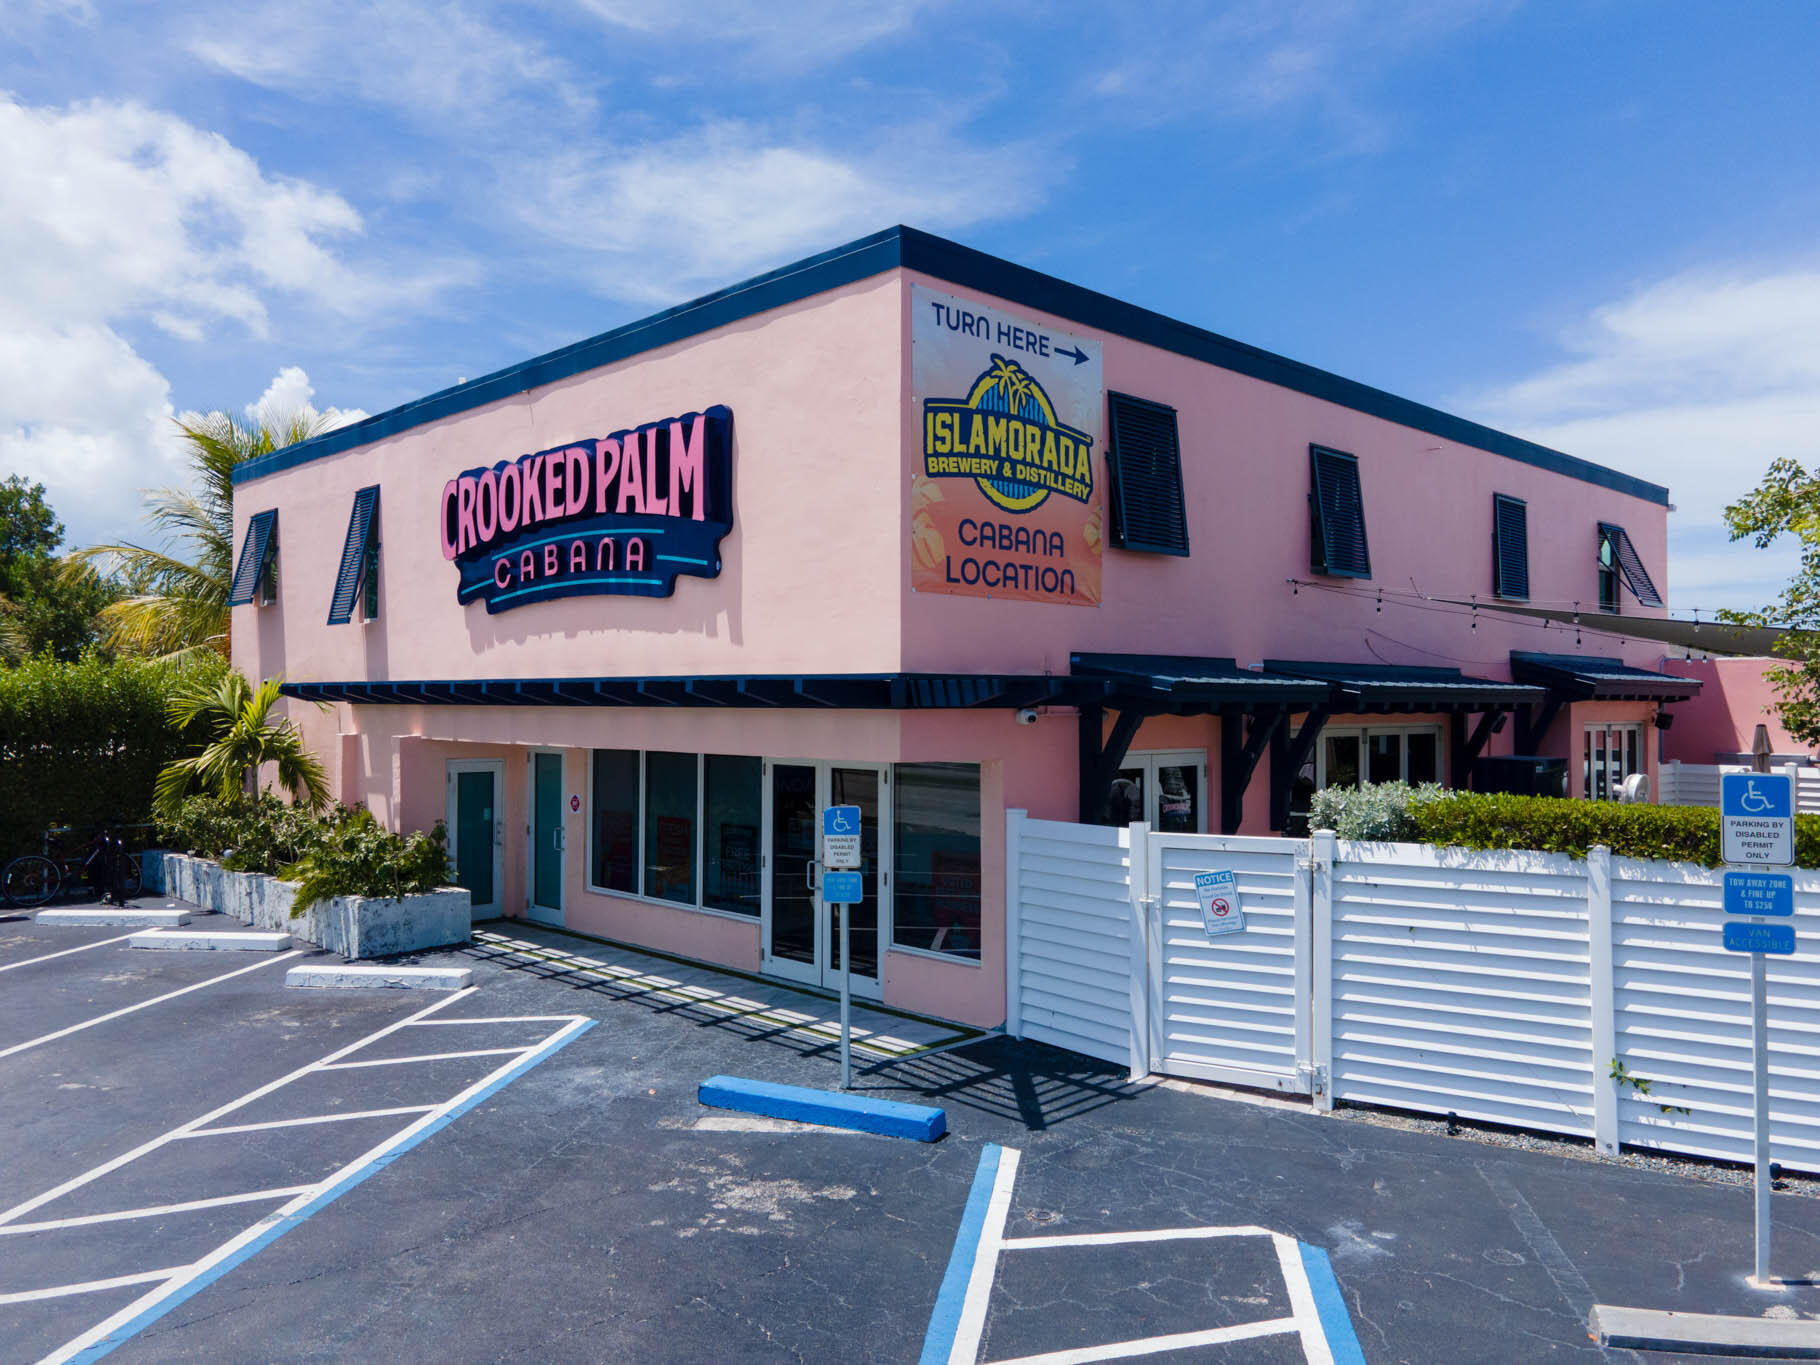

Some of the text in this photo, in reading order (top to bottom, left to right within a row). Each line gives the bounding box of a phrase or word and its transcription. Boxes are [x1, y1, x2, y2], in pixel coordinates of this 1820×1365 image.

[932, 302, 1050, 358] TURN HERE
[926, 412, 1091, 485] ISLAMORADA
[927, 456, 1091, 500] BREWERY & DISTILLERY
[440, 414, 706, 561] CROOKED PALM
[958, 518, 1064, 558] CABANA
[494, 536, 644, 589] CABANA
[946, 555, 1075, 595] LOCATION
[1730, 820, 1784, 829] PARKING BY
[1735, 831, 1780, 839] DISABLED
[1741, 841, 1774, 849] PERMIT
[1745, 852, 1770, 860] ONLY
[1196, 872, 1232, 886] NOTICE
[1729, 878, 1787, 889] TOW AWAY ZONE
[1748, 890, 1763, 898] FINE
[1766, 891, 1776, 899] UP
[1744, 901, 1753, 909] TO
[1747, 927, 1771, 938] VAN
[1729, 938, 1791, 950] ACCESSIBLE
